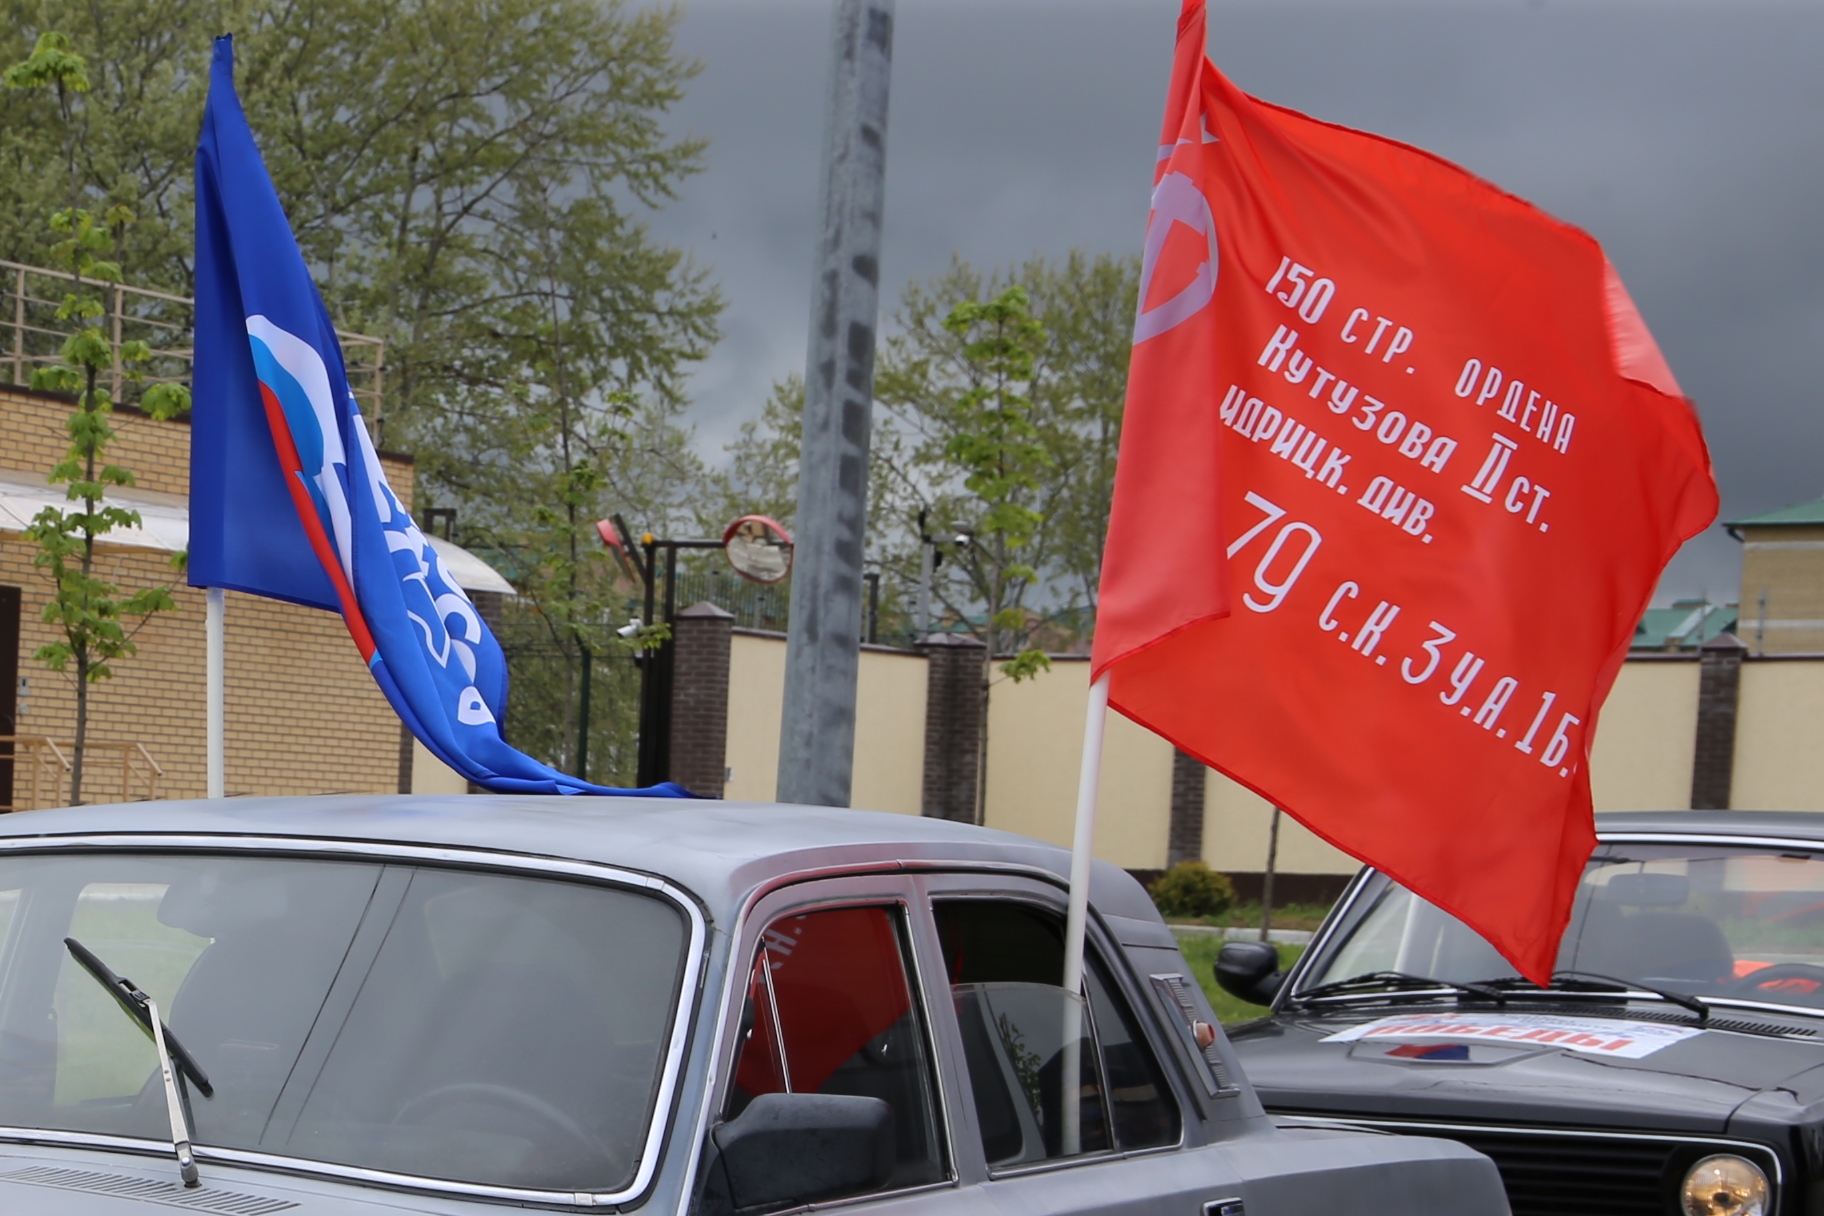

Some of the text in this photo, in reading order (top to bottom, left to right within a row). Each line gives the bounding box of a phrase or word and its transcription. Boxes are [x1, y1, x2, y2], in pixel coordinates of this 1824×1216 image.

[1265, 256, 1576, 454] 150 СТР. ОРДЕНА
[1226, 490, 1323, 613] 79
[1357, 475, 1434, 544] ДИВ.
